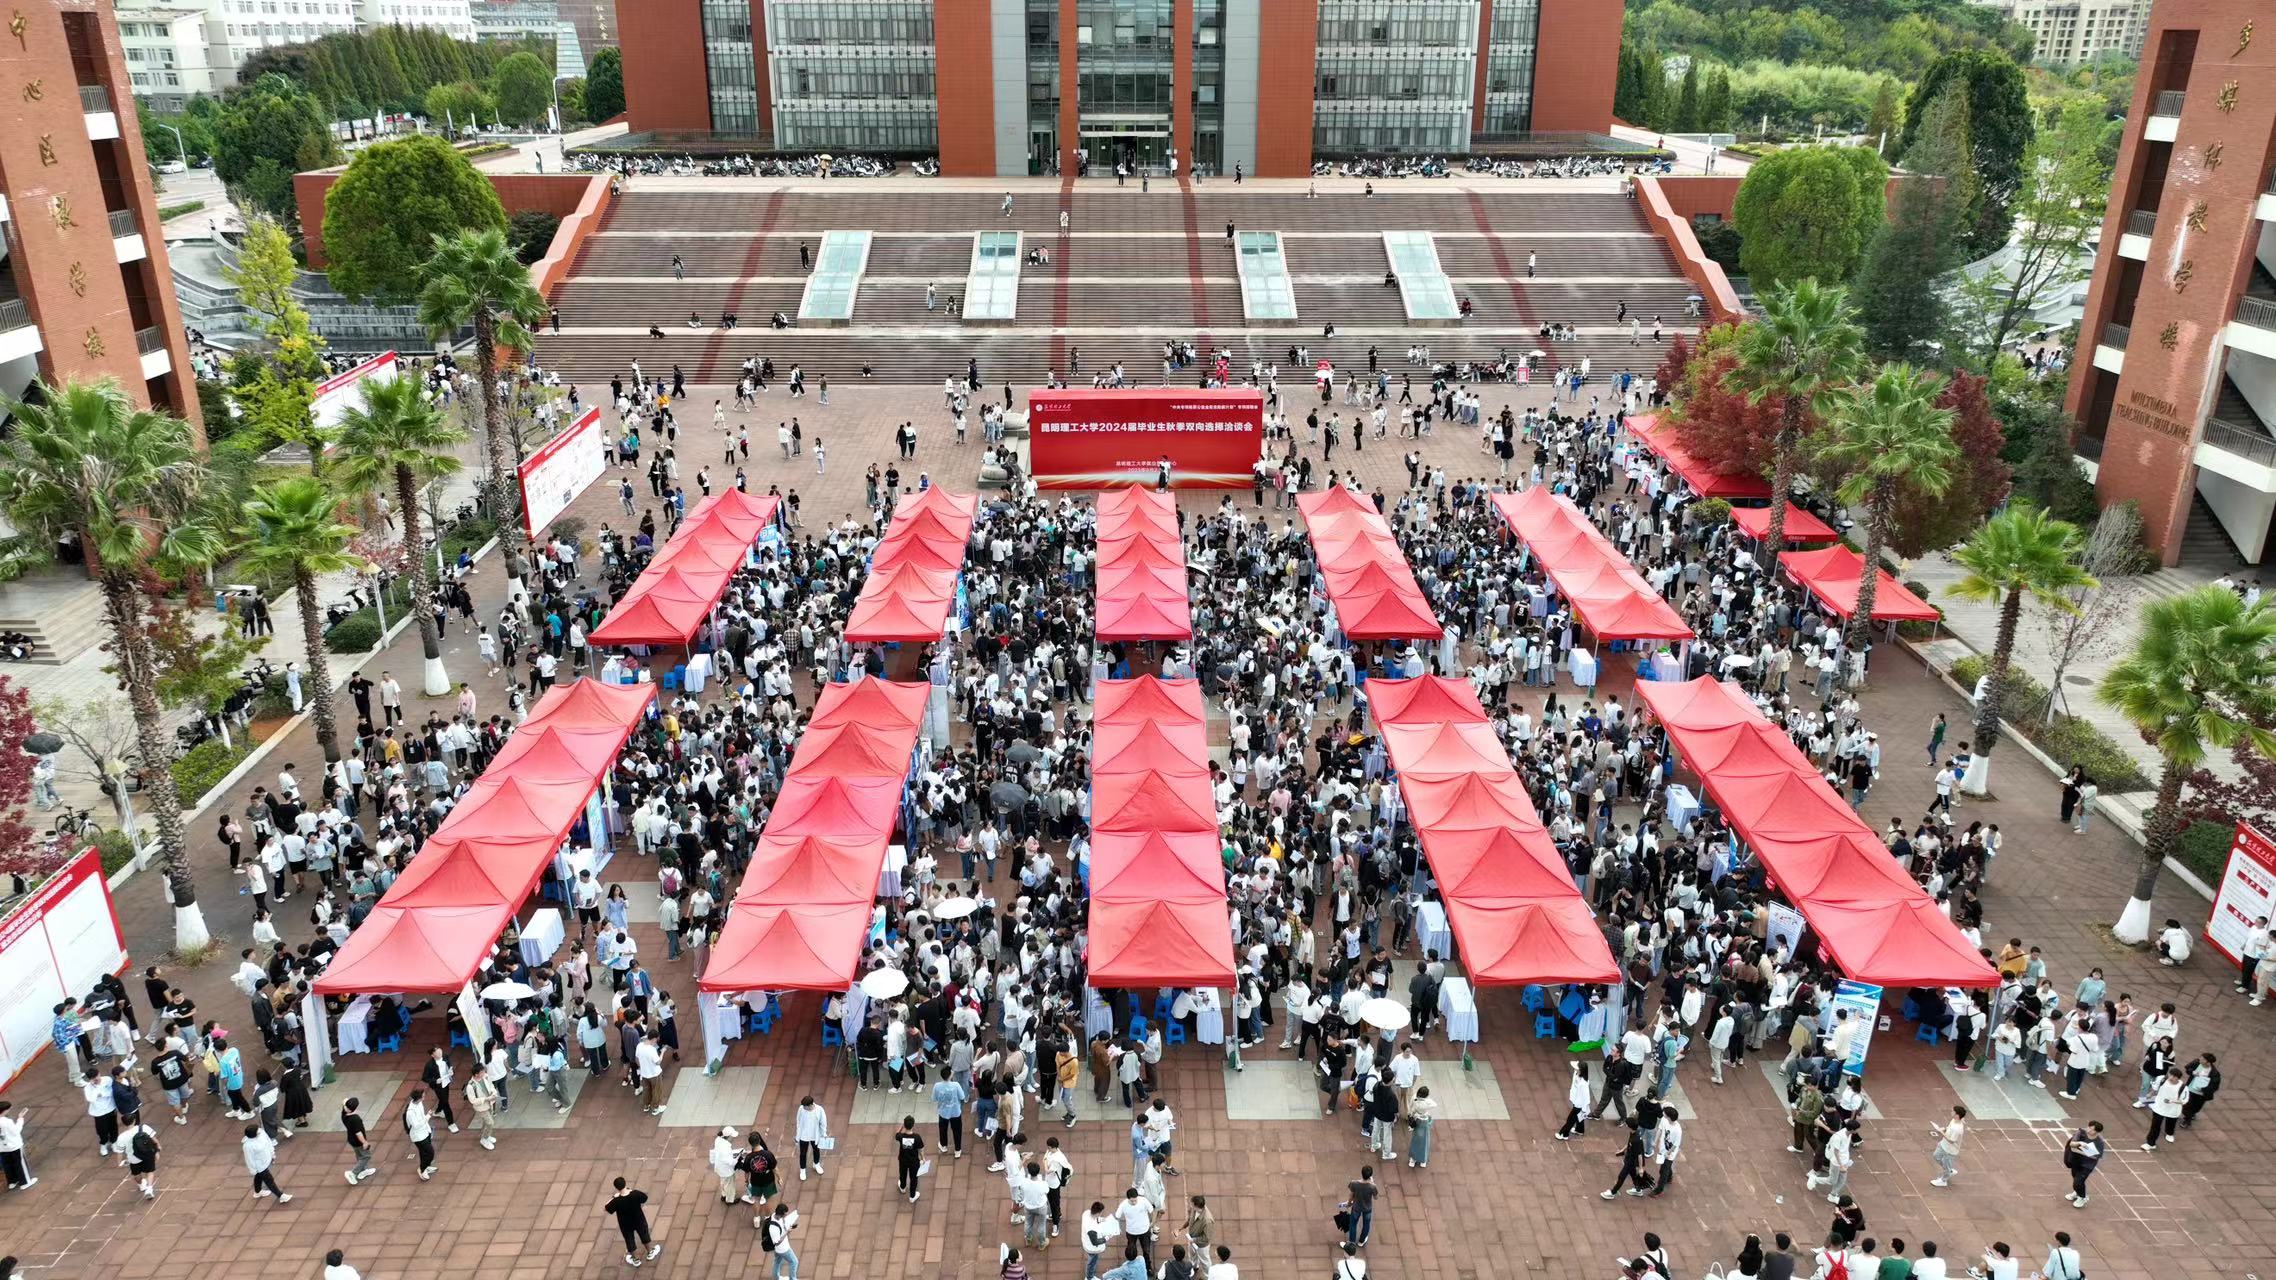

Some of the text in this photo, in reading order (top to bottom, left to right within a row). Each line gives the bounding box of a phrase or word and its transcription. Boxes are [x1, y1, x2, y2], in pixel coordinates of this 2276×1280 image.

[2131, 390, 2177, 419] MULTIMEDIA
[1041, 422, 1253, 432] 昆明理工大学2024届毕业生秋季双向选择洽谈会
[2116, 403, 2190, 442] TEACHING BUILDING
